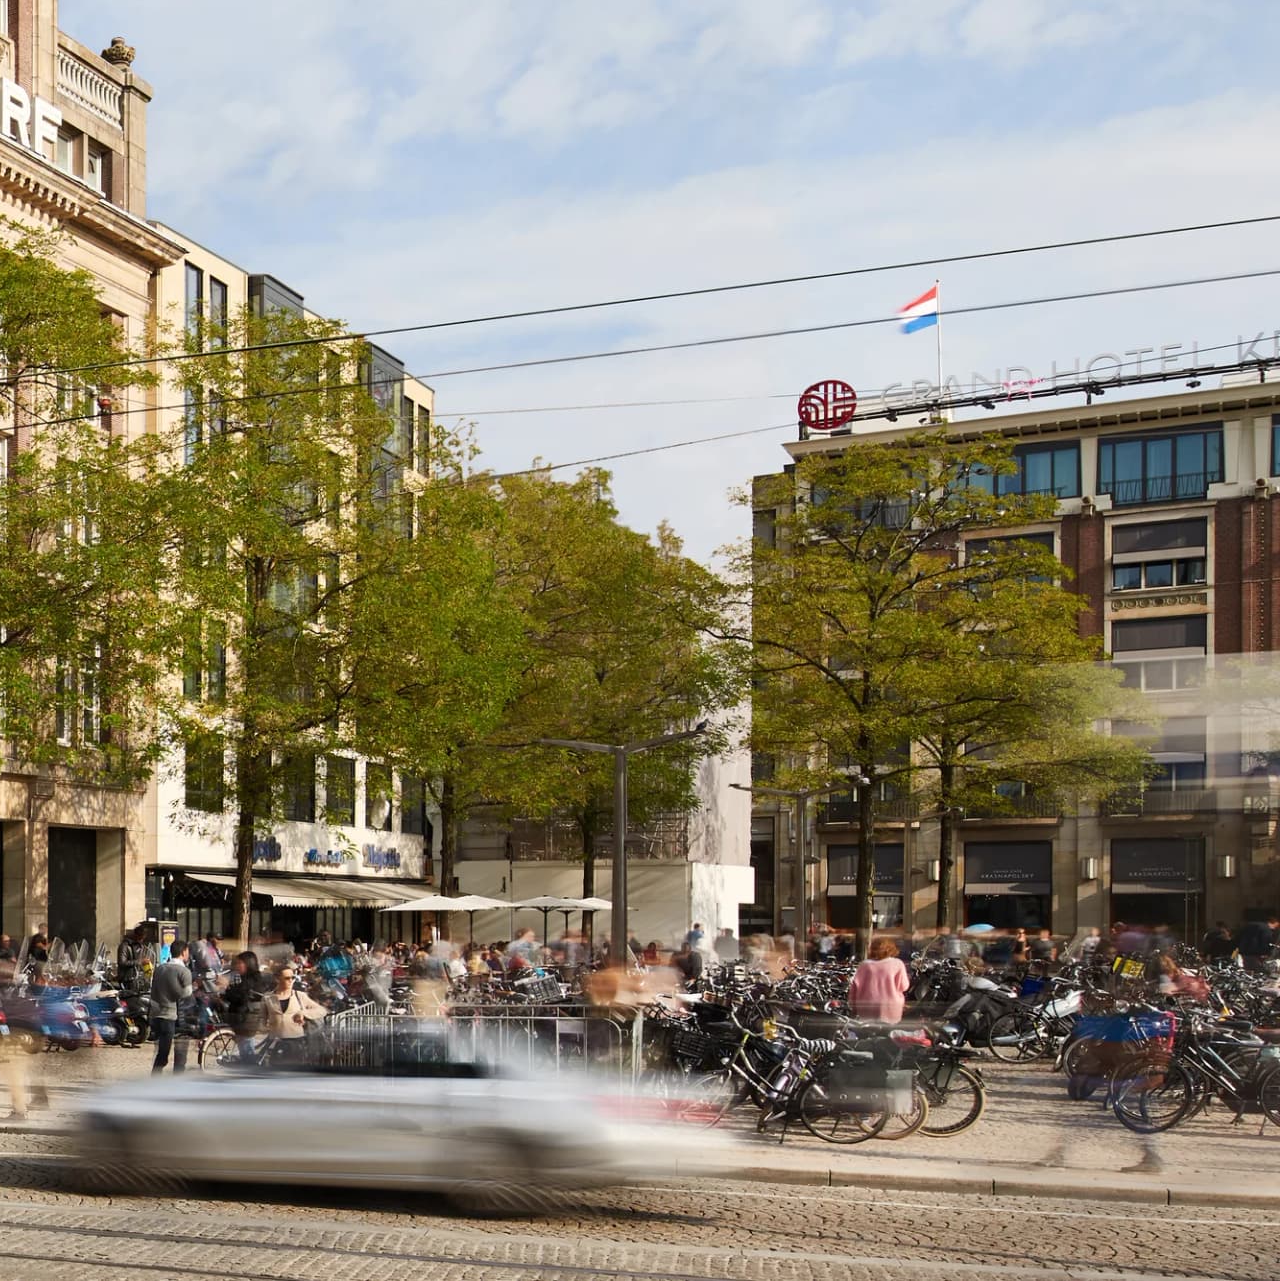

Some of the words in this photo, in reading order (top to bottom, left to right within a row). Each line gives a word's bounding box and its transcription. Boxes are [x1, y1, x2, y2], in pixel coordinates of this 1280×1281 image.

[880, 365, 1033, 407] GRAND
[1051, 339, 1216, 389] HOTEL
[1237, 329, 1280, 364] K
